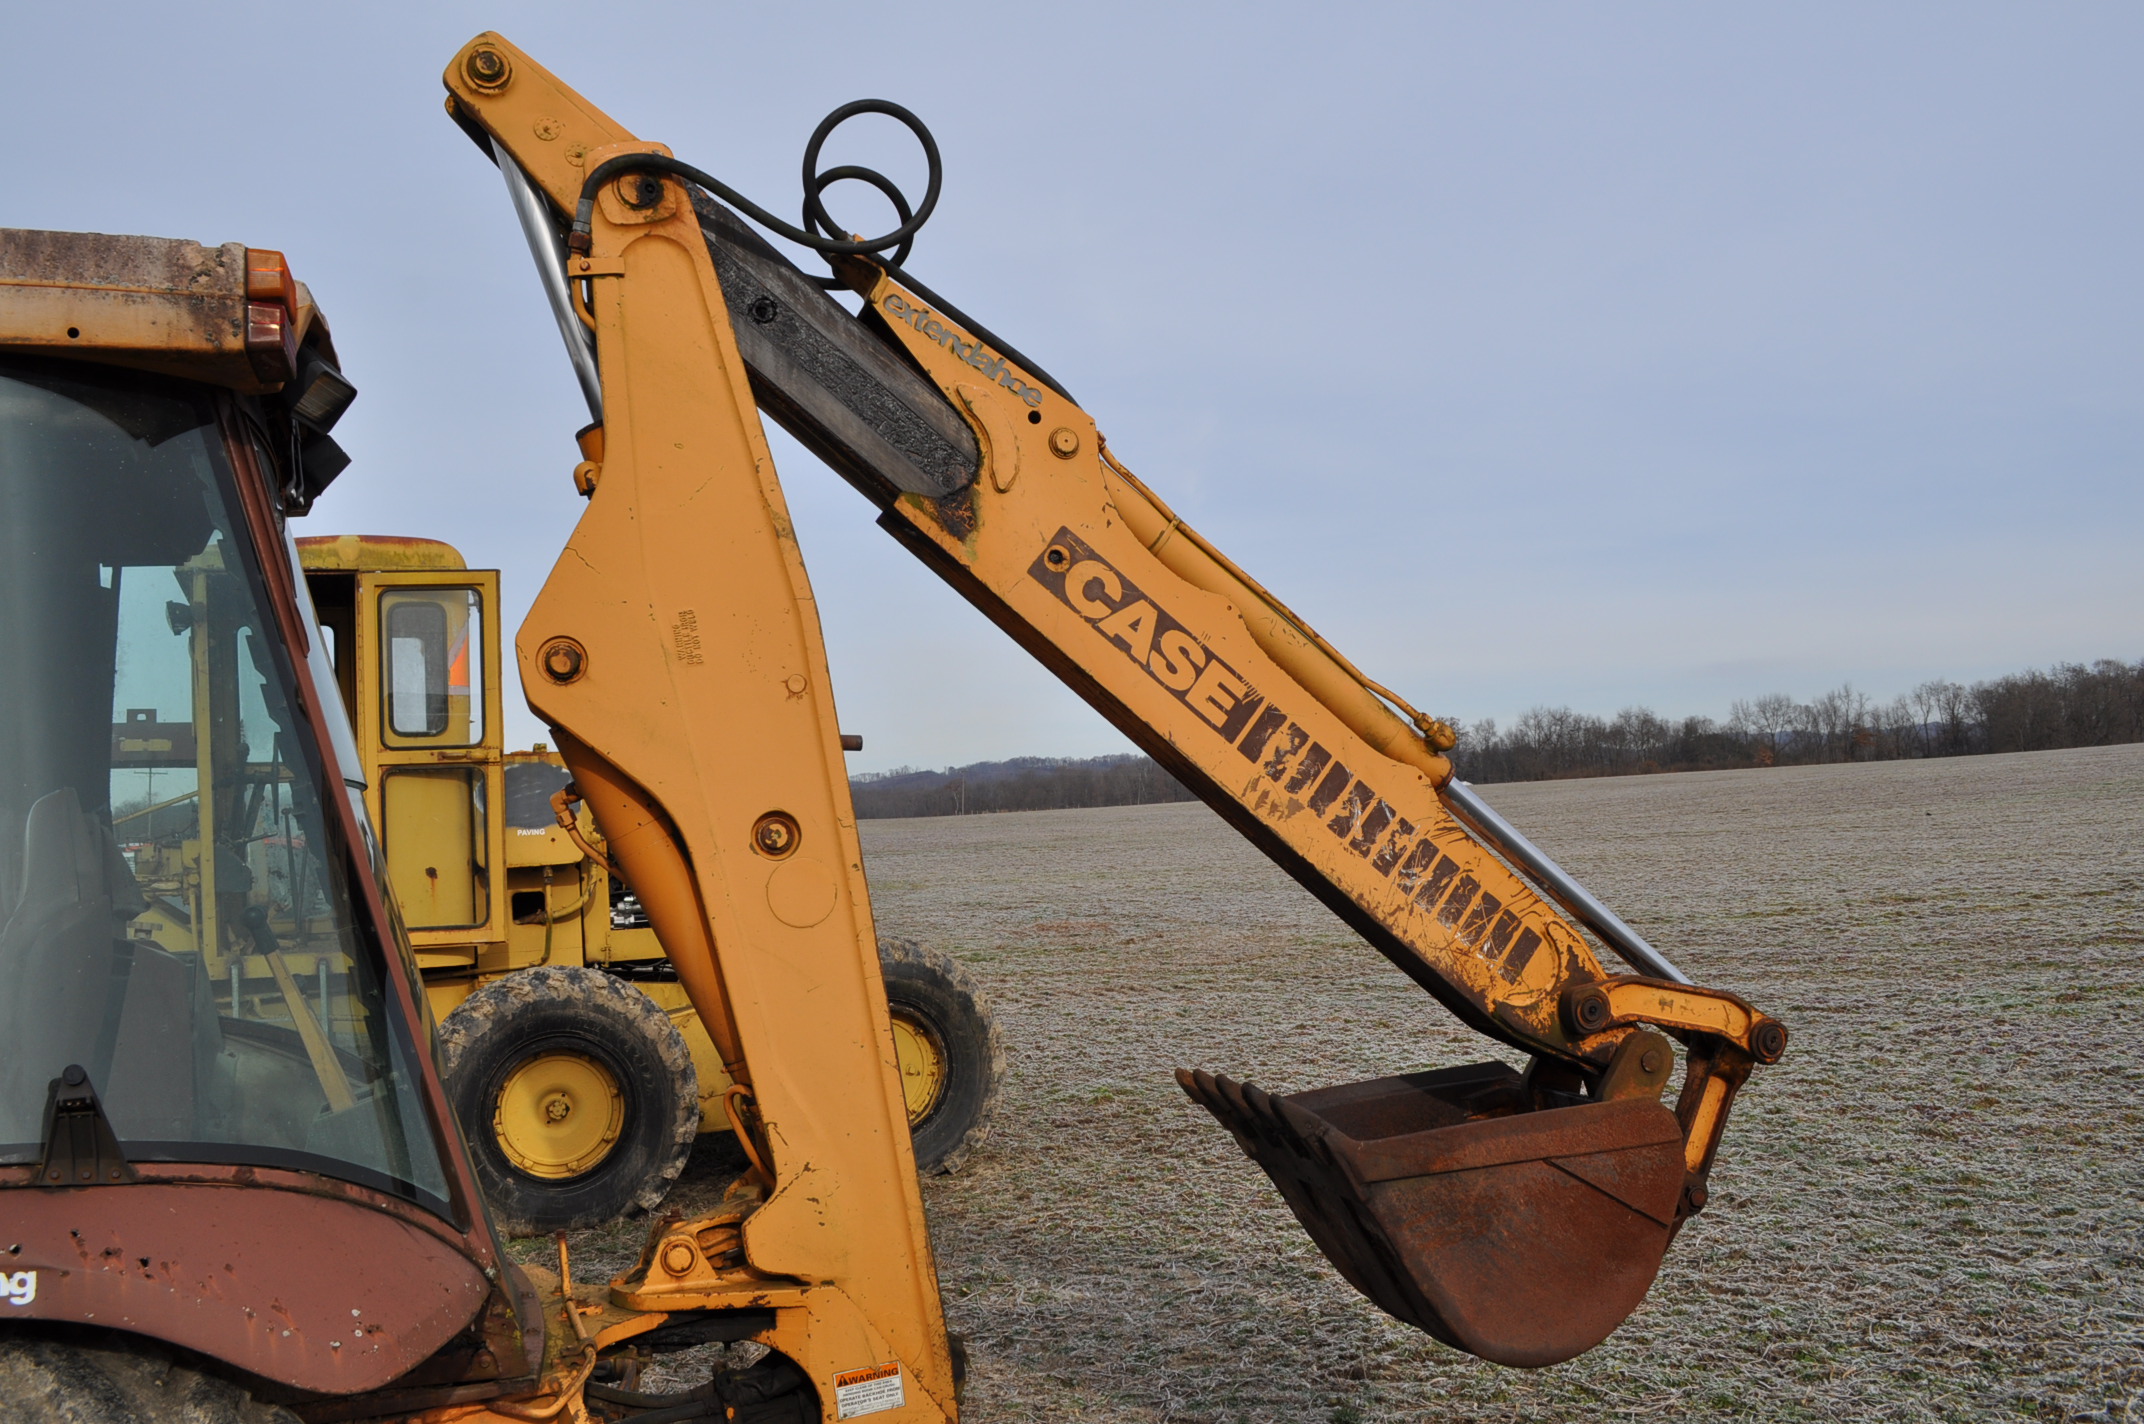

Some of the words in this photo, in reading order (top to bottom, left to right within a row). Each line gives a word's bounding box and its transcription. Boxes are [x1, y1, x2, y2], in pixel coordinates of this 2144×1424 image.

[884, 294, 1043, 407] extendahoe
[1064, 559, 1246, 729] CASE
[517, 828, 546, 837] PAVING
[848, 1368, 899, 1384] WARNING
[839, 1394, 861, 1402] OPERATE
[861, 1389, 885, 1397] BACKHOE
